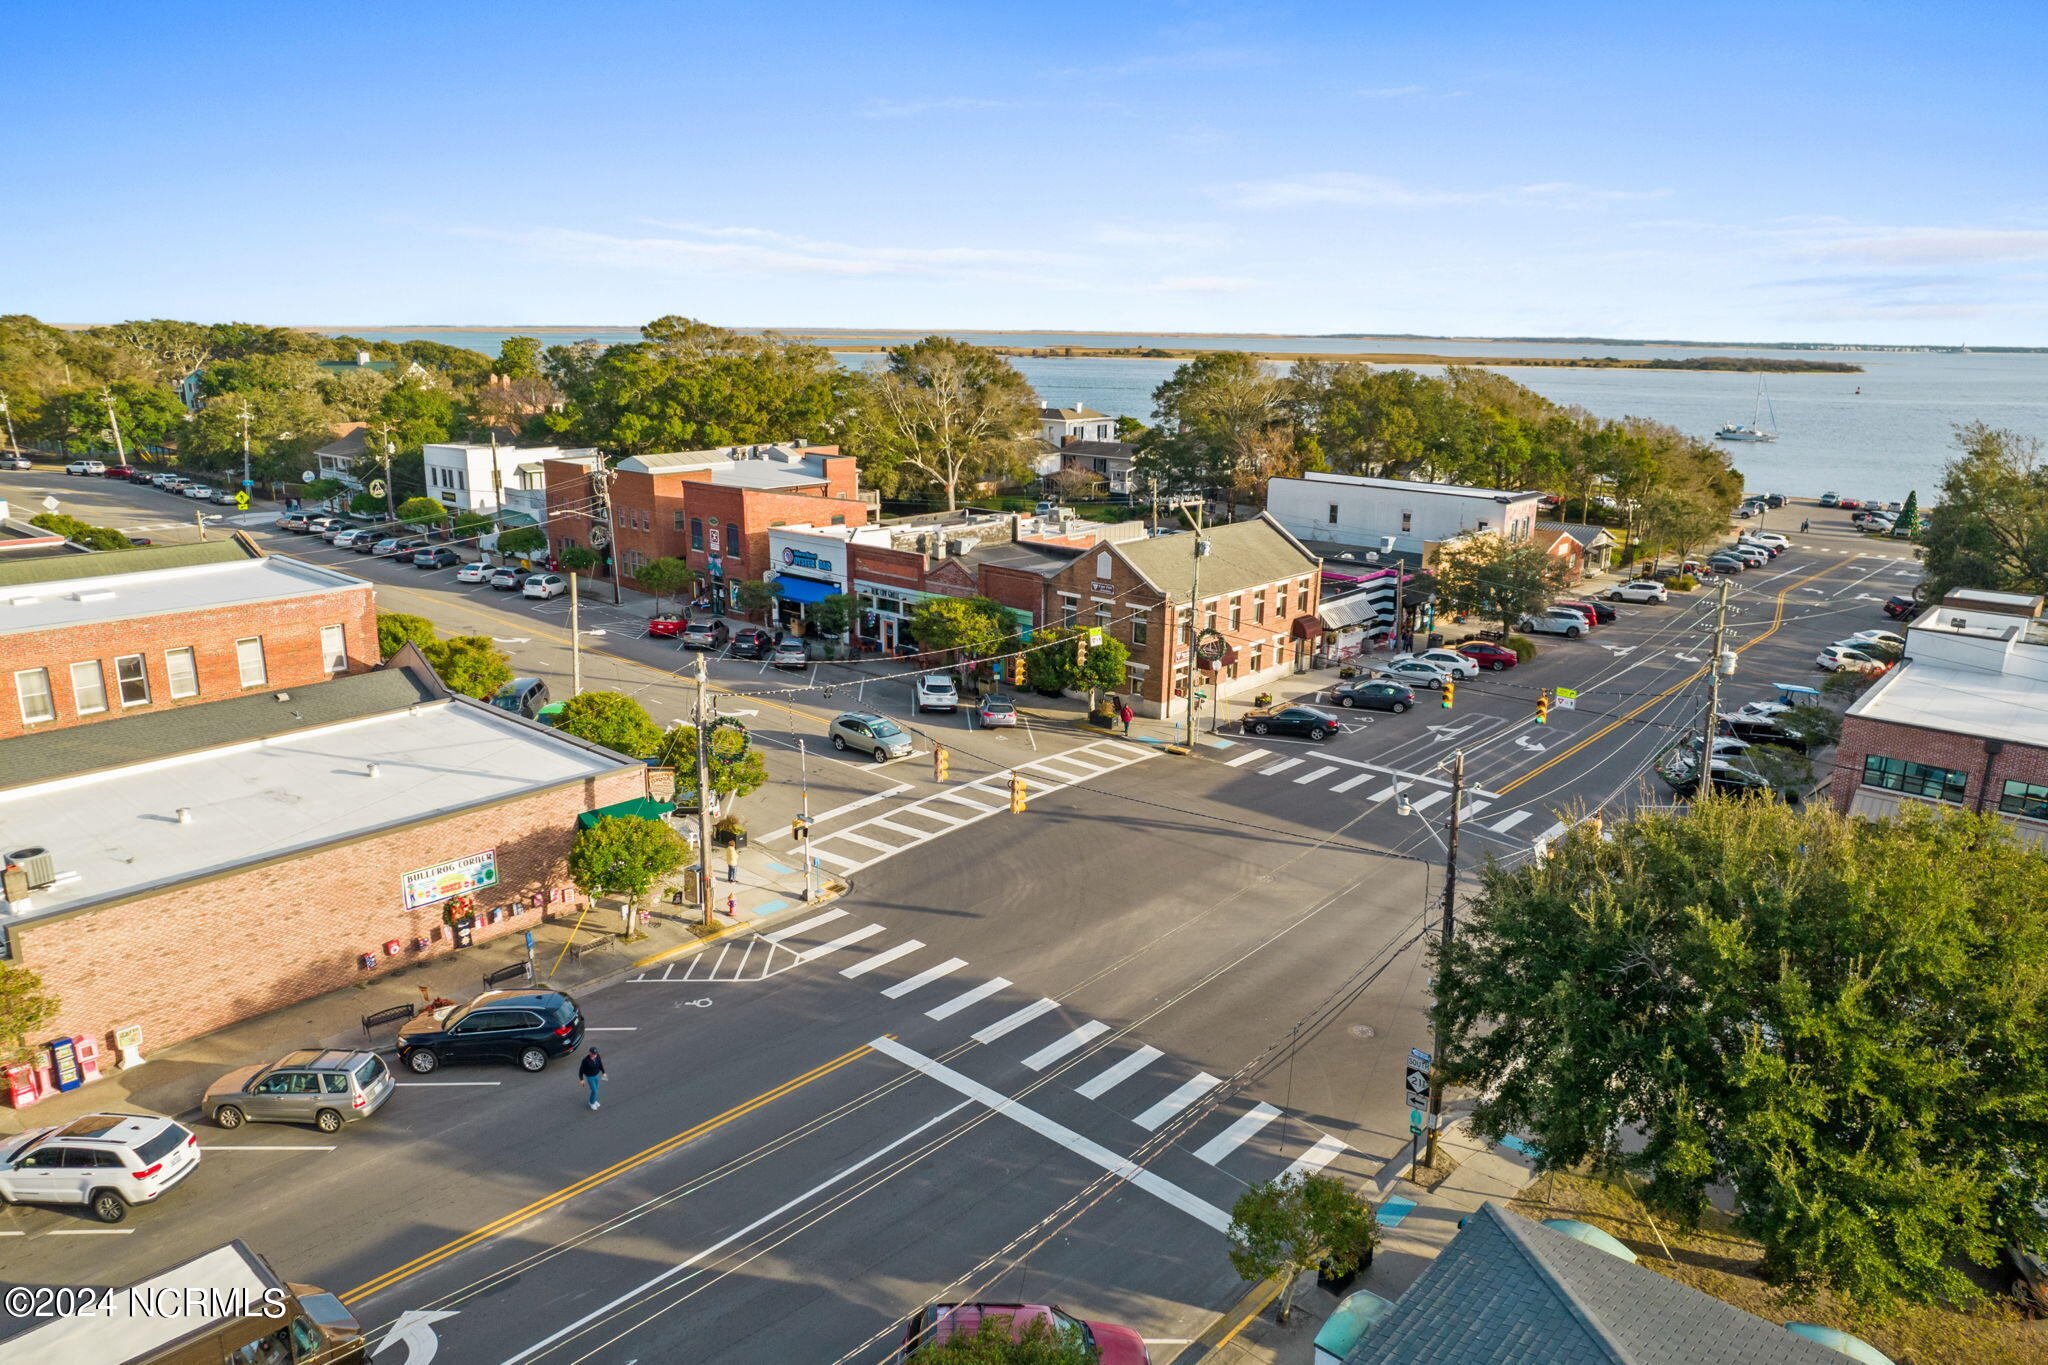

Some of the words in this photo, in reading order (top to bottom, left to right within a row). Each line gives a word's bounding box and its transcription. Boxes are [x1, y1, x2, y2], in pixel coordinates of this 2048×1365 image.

[407, 863, 455, 883] BULLFROG
[459, 853, 492, 868] CORNER
[1409, 1057, 1430, 1072] SOUTH
[1411, 1076, 1426, 1088] 211
